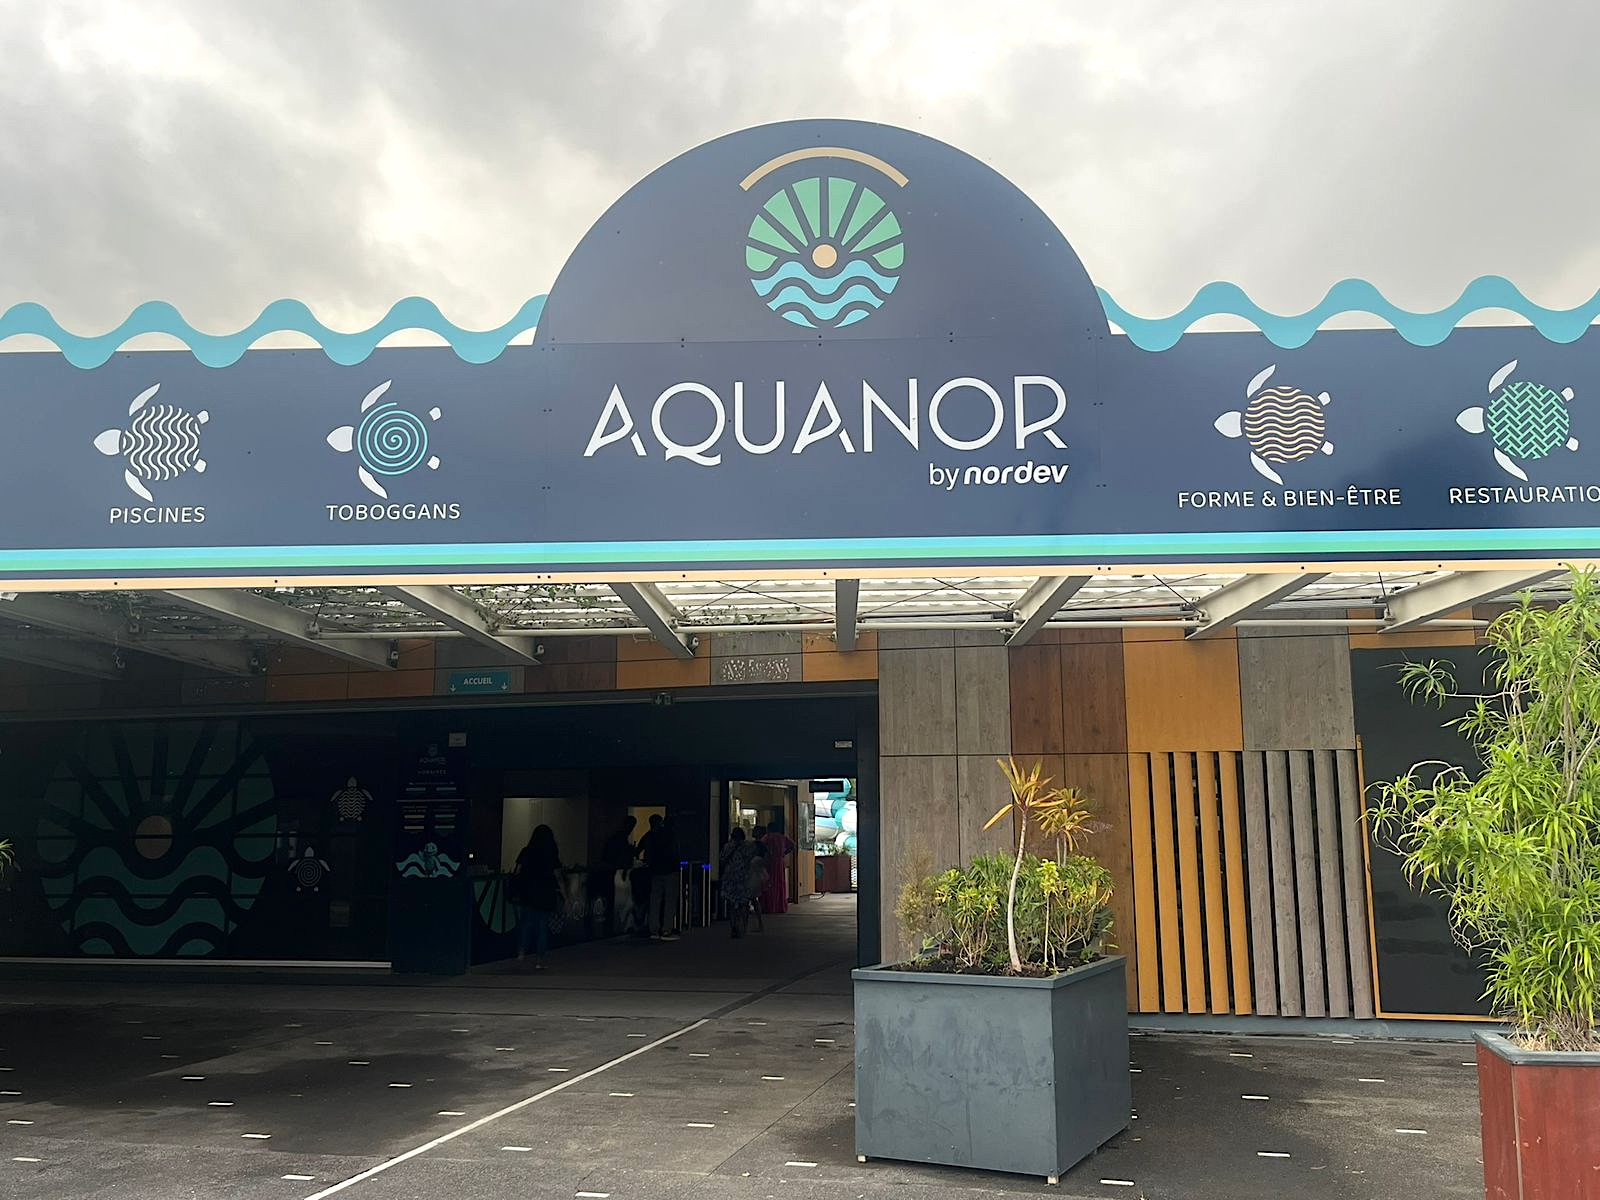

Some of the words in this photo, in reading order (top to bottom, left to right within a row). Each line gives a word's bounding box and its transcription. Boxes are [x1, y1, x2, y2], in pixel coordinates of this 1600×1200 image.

[583, 375, 1068, 466] AQUANOR
[929, 462, 960, 491] by
[963, 460, 1070, 485] nordev
[1178, 491, 1255, 508] FORME
[1261, 490, 1277, 507] &
[1284, 485, 1401, 507] BIEN-ÊTRE
[109, 506, 206, 524] PISCINES
[325, 503, 461, 521] TOBOGGANS
[463, 676, 493, 685] ACCUEIL
